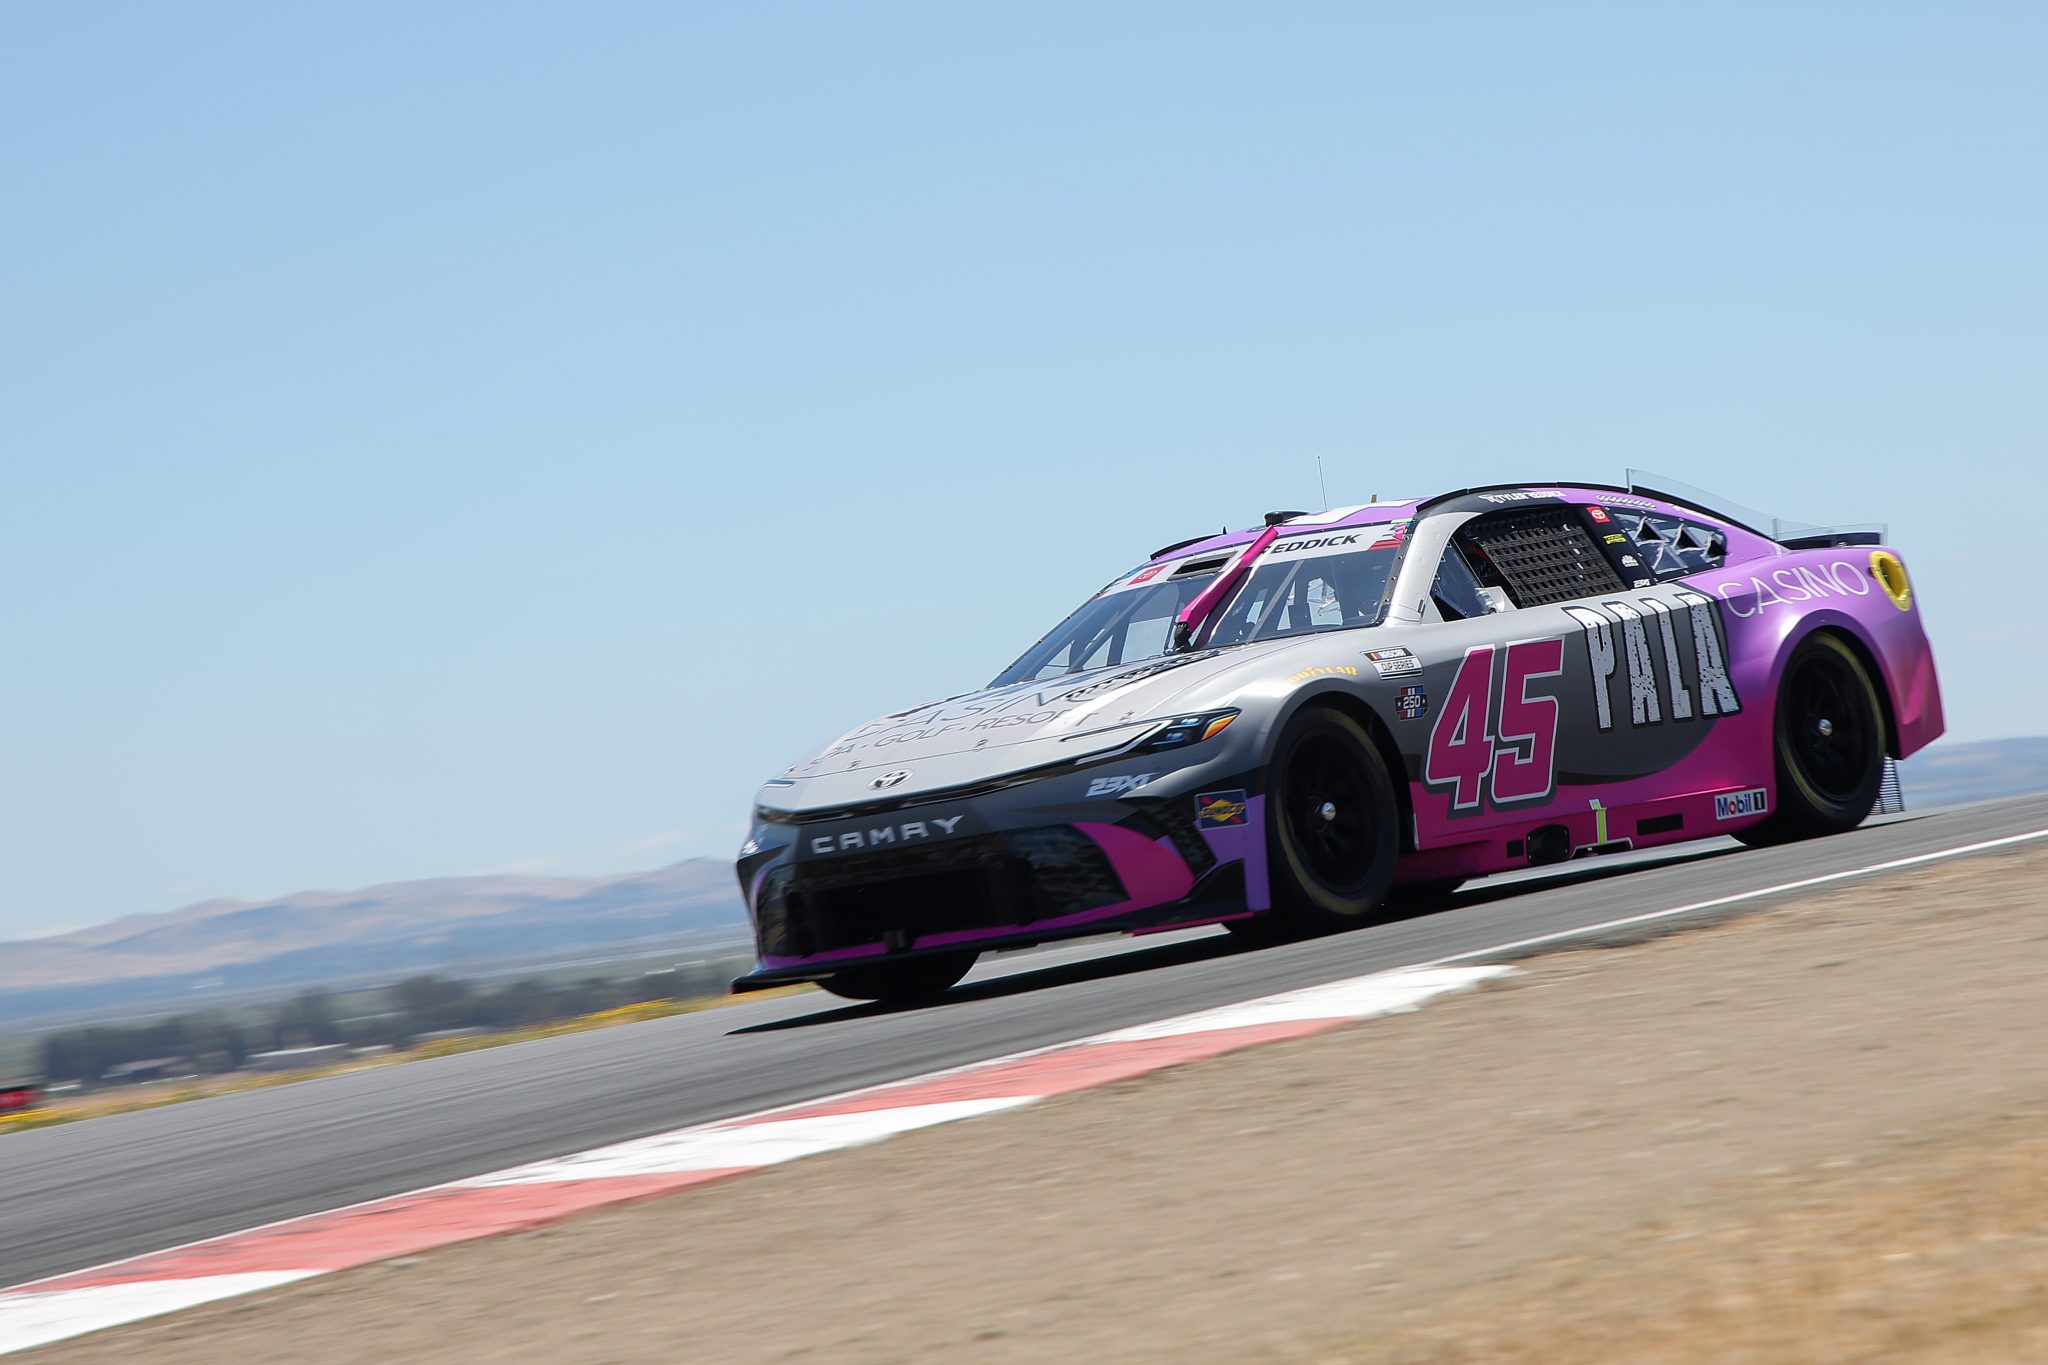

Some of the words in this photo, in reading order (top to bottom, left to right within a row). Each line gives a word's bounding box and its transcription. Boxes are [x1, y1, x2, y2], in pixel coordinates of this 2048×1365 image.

[1718, 561, 1870, 617] CASINO
[1393, 659, 1415, 670] SERIES
[1562, 592, 1741, 729] PALA
[1403, 695, 1421, 709] 250
[874, 723, 953, 748] GOLF
[1426, 635, 1566, 810] 45
[1717, 794, 1752, 818] Mobil
[1754, 791, 1766, 811] 1
[811, 815, 966, 855] CAMRY
